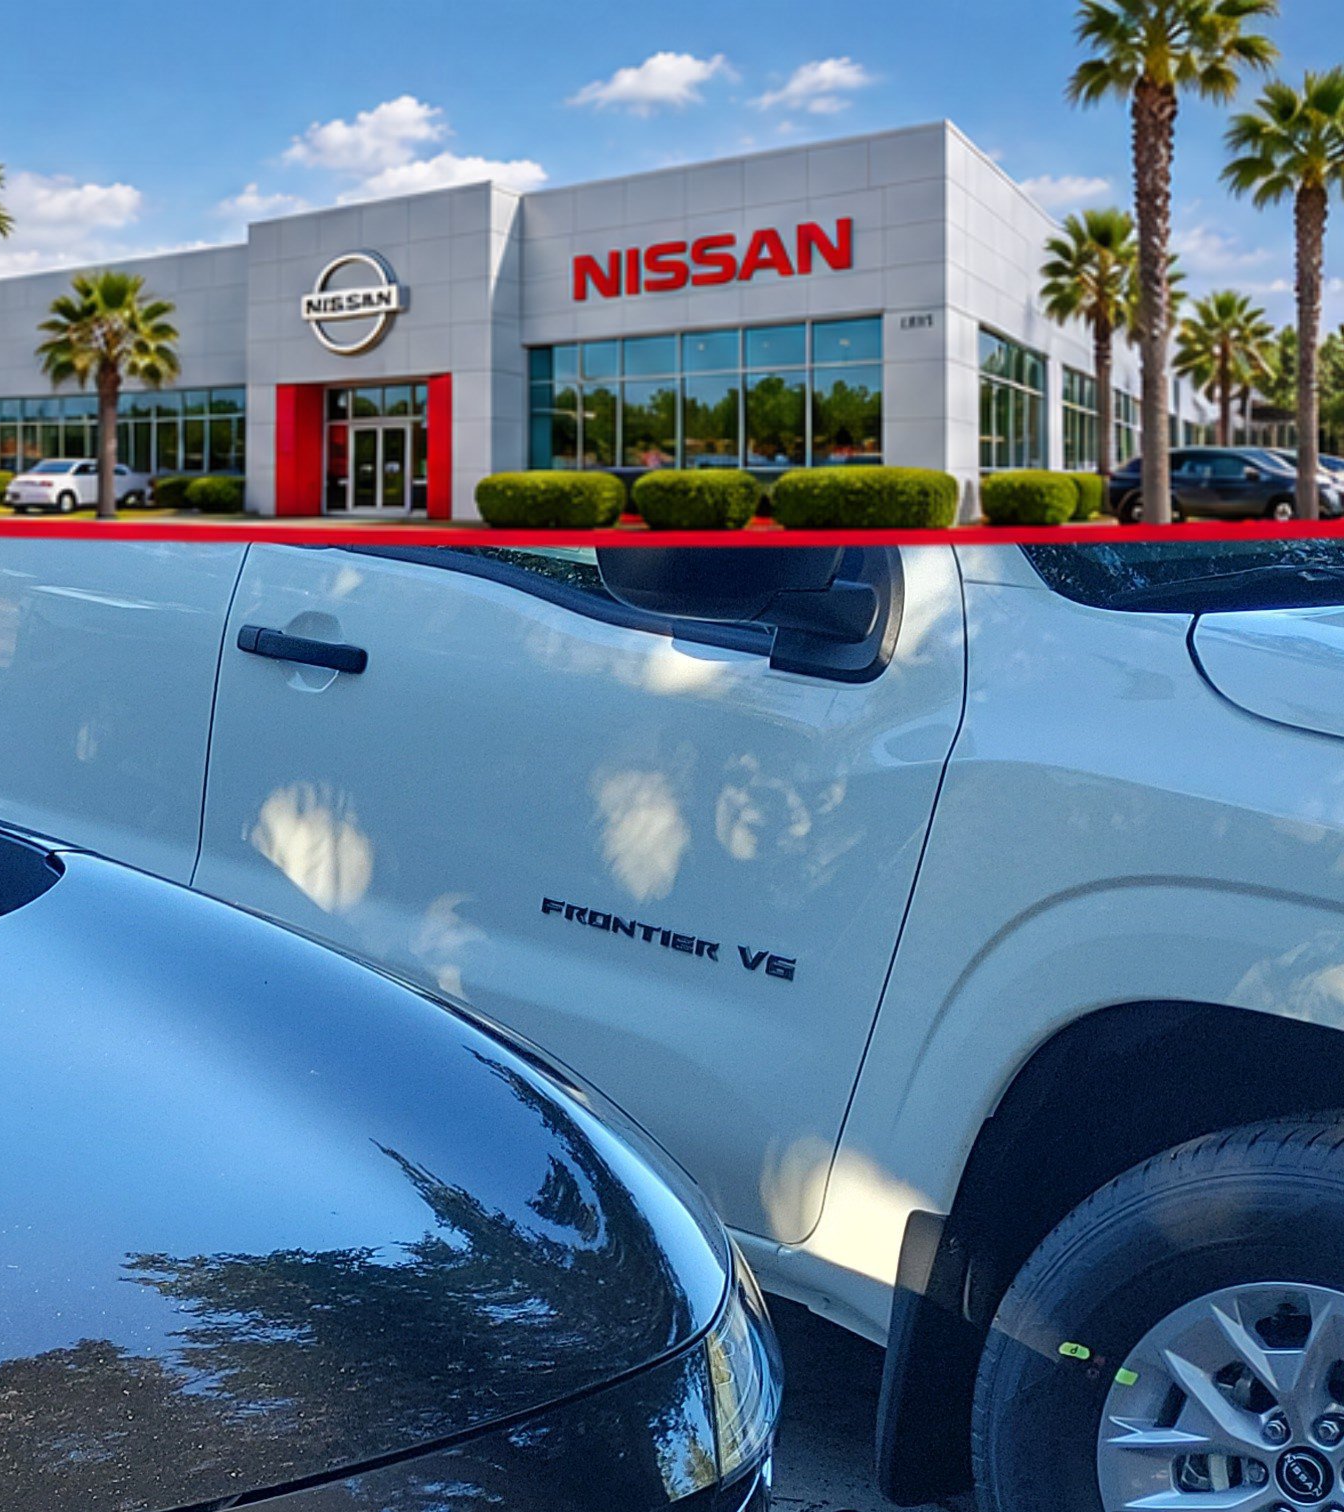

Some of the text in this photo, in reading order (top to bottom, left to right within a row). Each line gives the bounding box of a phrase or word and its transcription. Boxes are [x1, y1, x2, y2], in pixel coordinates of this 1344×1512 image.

[572, 216, 853, 302] NISSAN
[306, 290, 392, 315] NISSAN
[540, 896, 798, 982] FRONTIER V6
[1283, 1453, 1323, 1498] NISSAN
